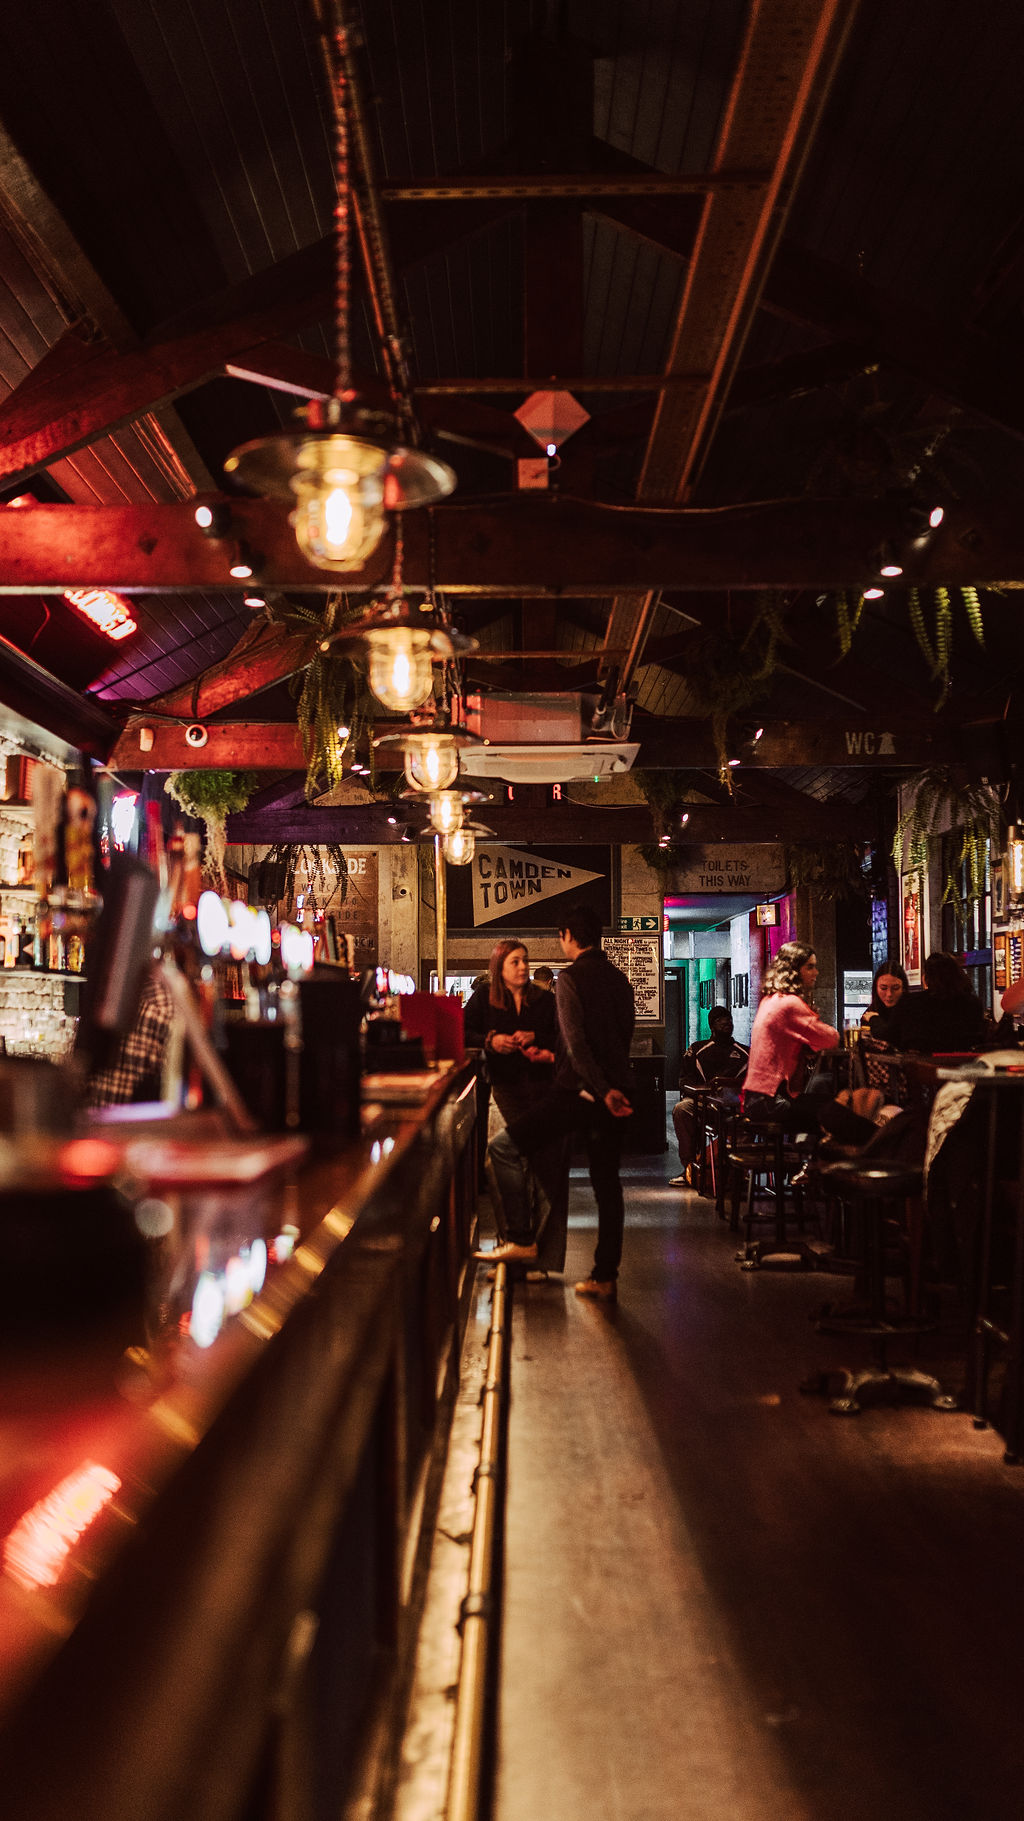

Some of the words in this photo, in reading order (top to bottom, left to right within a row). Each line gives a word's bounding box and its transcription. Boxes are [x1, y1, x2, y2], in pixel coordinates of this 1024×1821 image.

[845, 731, 875, 755] WC
[478, 853, 571, 879] CAMDEN
[703, 860, 749, 872] TOILETS
[699, 875, 724, 887] THIS
[727, 874, 752, 887] WAY
[480, 879, 542, 908] TOWN
